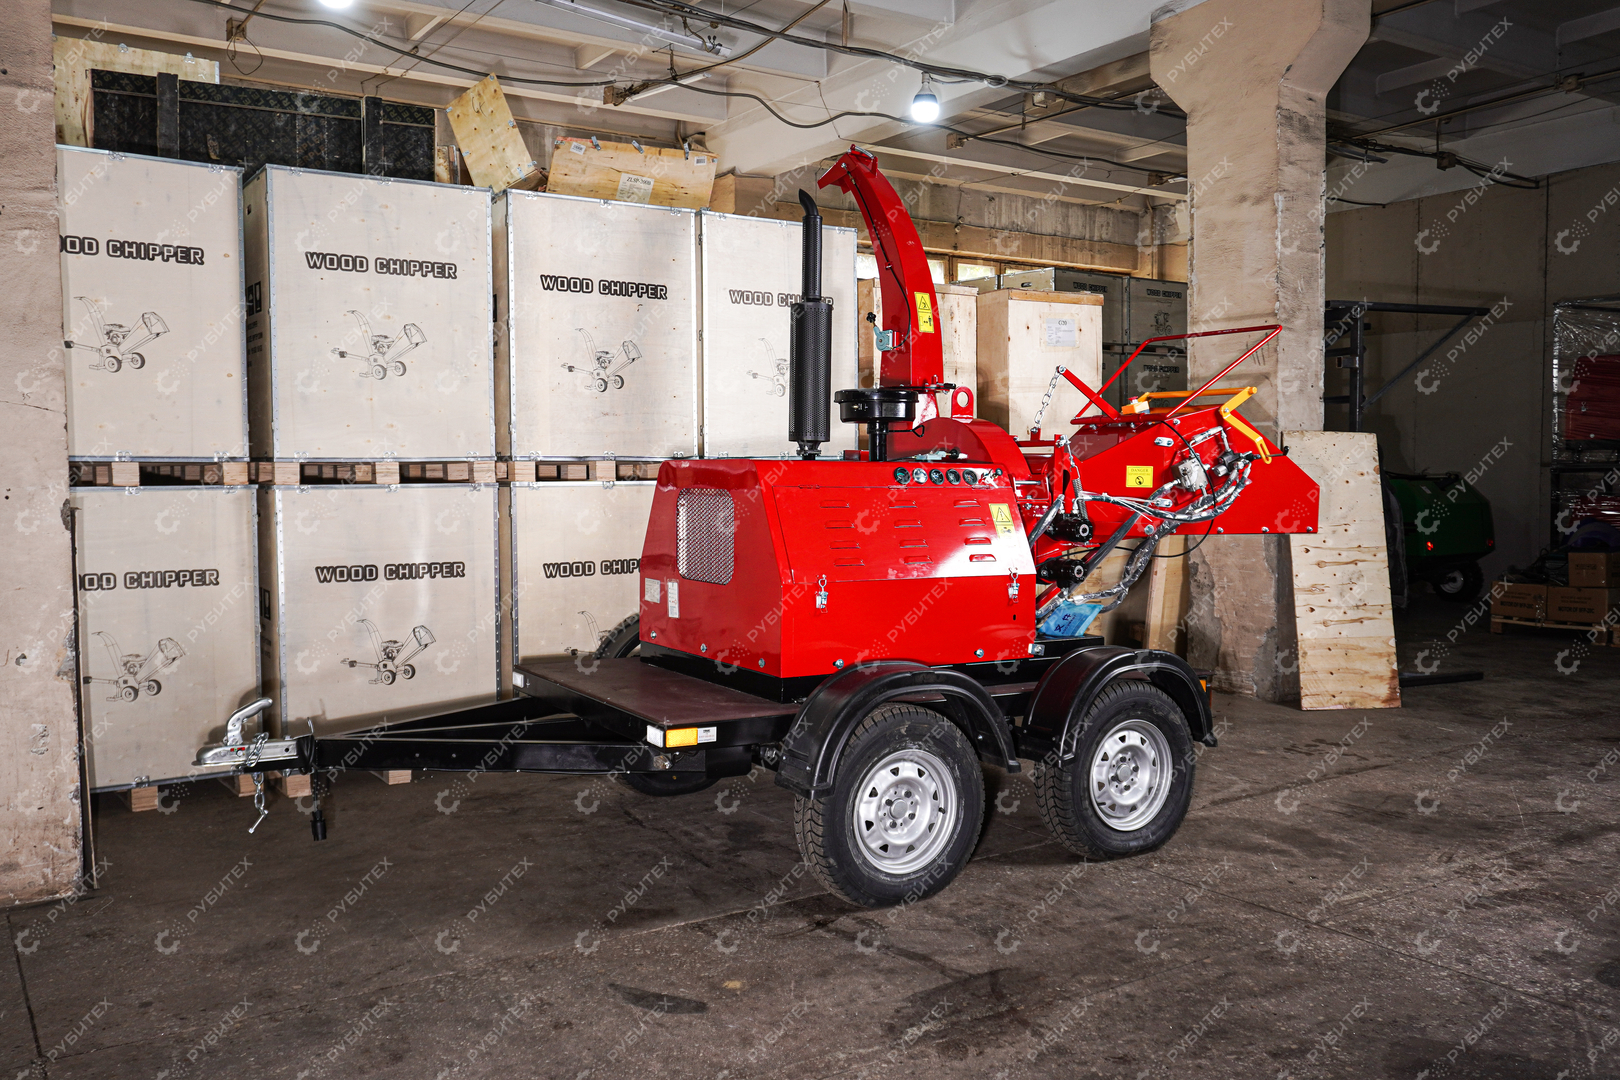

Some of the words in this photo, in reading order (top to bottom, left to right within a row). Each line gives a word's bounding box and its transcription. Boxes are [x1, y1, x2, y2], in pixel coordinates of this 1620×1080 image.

[106, 239, 204, 265] CHIPPER
[305, 252, 368, 272] WOOD
[375, 257, 457, 279] CHIPPER
[540, 275, 593, 293] WOOD
[598, 279, 667, 300] CHIPPER
[729, 290, 773, 306] WOOD
[124, 569, 219, 589] CHIPPER
[315, 564, 378, 583] WOOD
[384, 561, 465, 580] CHIPPER
[543, 561, 596, 578] WOOD
[600, 558, 641, 575] CHIP
